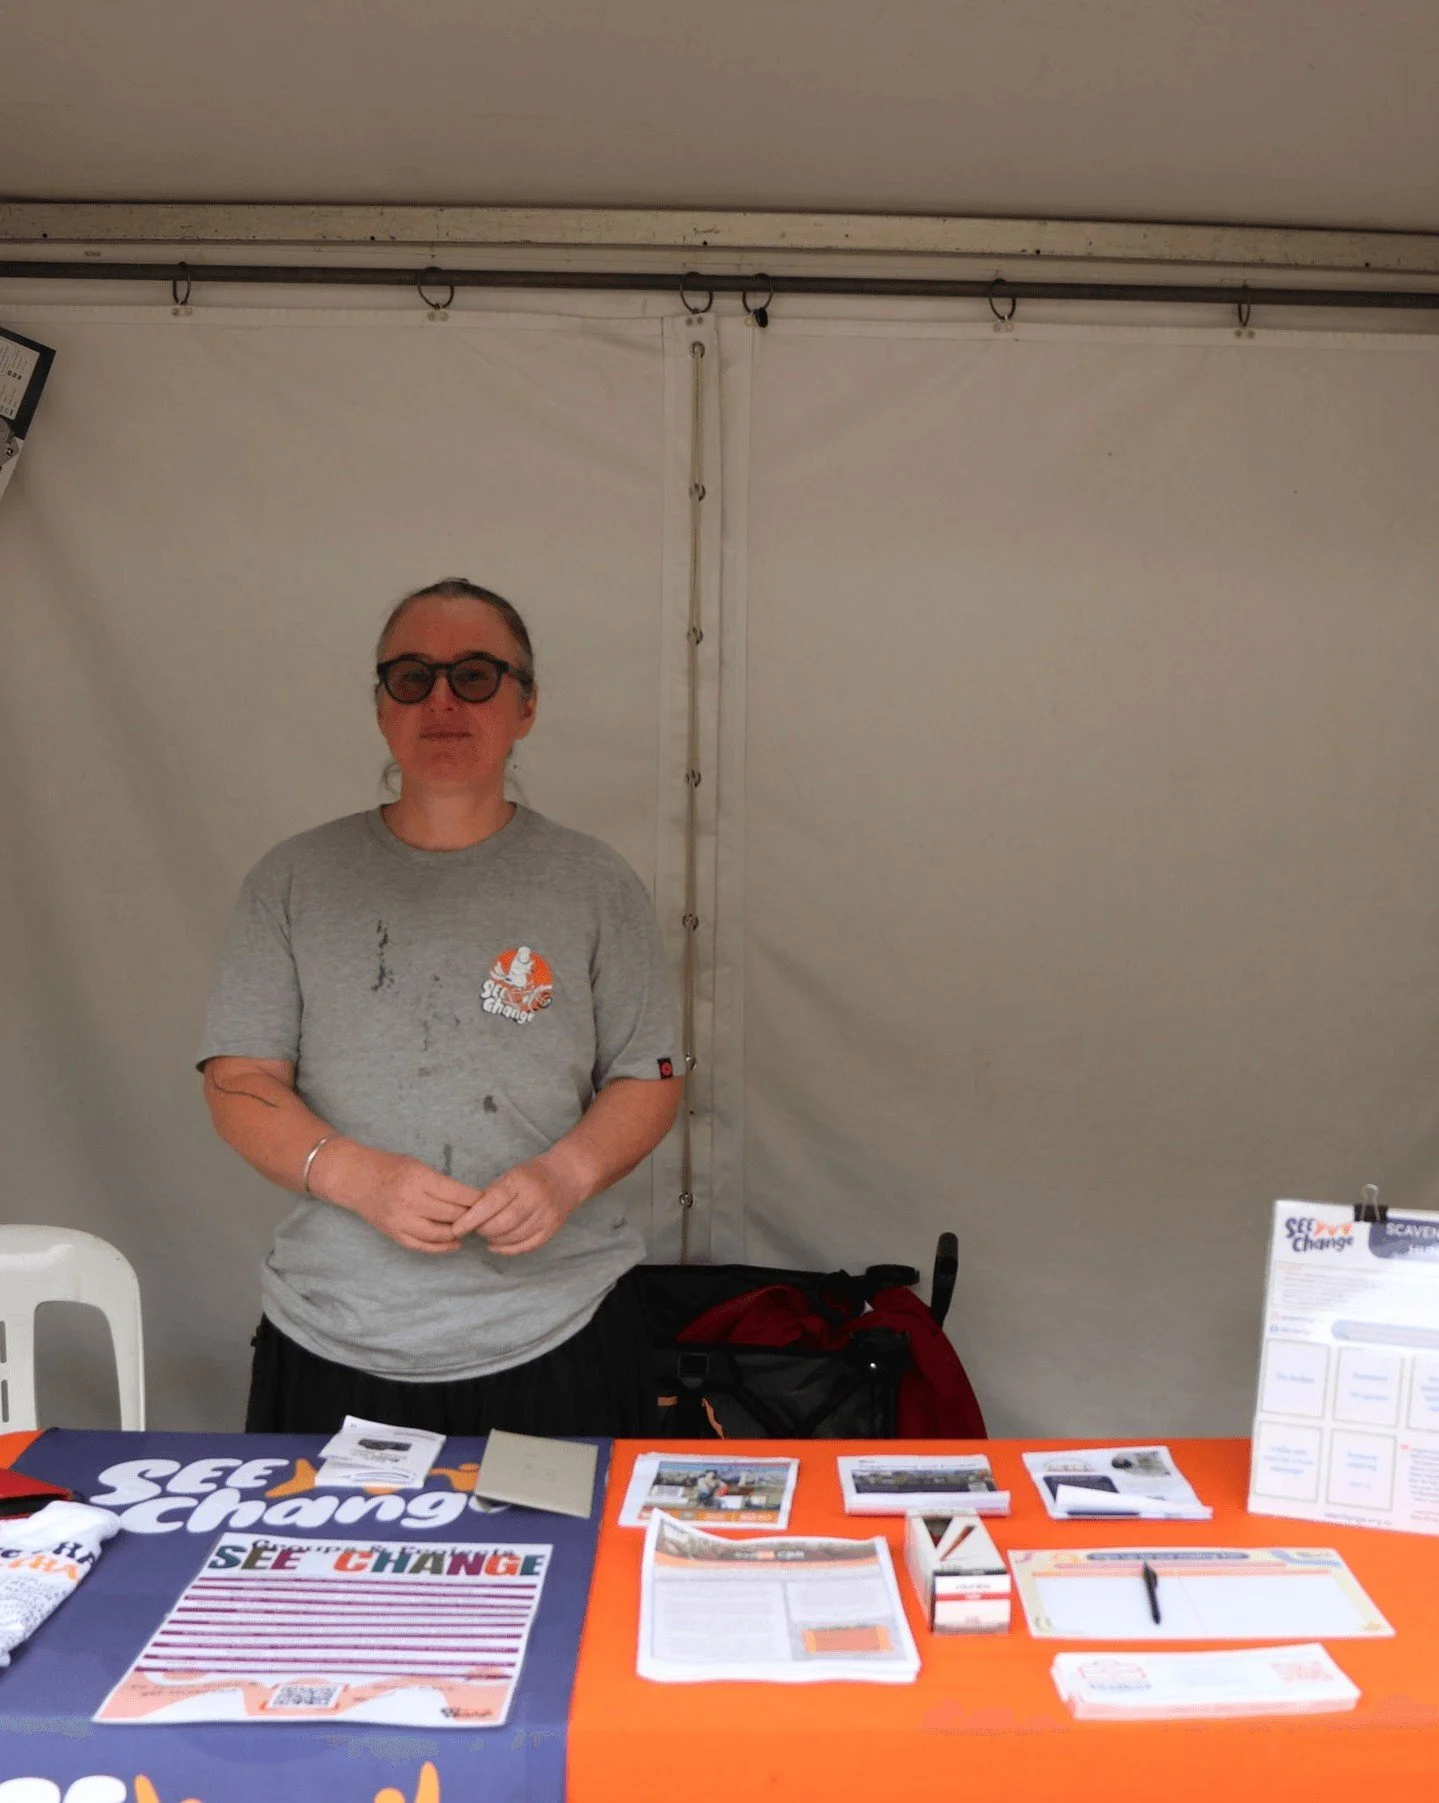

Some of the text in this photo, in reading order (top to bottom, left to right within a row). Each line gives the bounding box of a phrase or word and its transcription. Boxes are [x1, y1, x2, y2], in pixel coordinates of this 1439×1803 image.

[1292, 1233, 1354, 1252] Change
[90, 1458, 290, 1505] SEE
[207, 1545, 302, 1571] SEE
[333, 1551, 545, 1576] CHANGE
